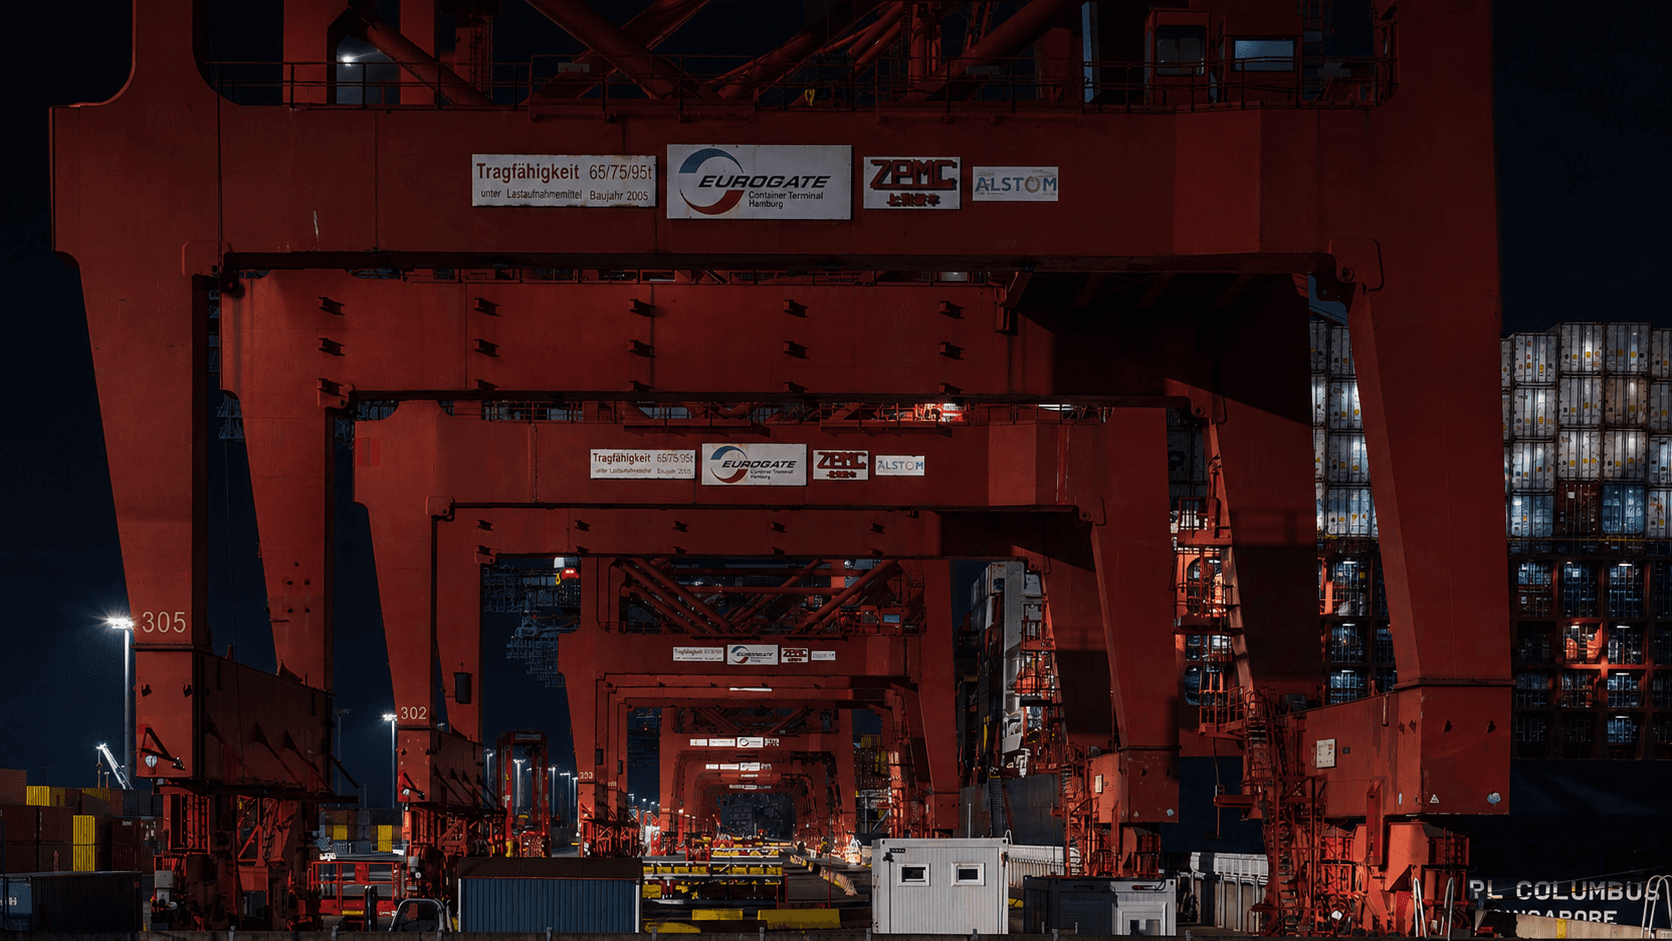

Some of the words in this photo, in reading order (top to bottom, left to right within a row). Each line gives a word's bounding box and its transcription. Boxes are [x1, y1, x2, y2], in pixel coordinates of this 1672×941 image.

[476, 163, 579, 184] Tragfähigkeit
[589, 164, 652, 180] 65/75/95t
[870, 159, 958, 190] ZPMC
[698, 175, 832, 188] EUROGATE
[974, 175, 1057, 194] ALSTOM
[480, 189, 501, 198] unter
[506, 188, 583, 199] Lastaufnahmemittel
[589, 190, 624, 202] Baujahr
[626, 190, 649, 201] 2005
[748, 190, 786, 199] Container
[788, 191, 824, 200] Terminal
[748, 200, 784, 209] Hamburg
[592, 452, 651, 465] Tragfähigkeit
[721, 460, 797, 469] EUROGATE
[877, 460, 924, 470] ALSTOM
[142, 611, 186, 633] 305
[400, 706, 427, 720] 302
[1516, 879, 1661, 901] COLUMBUS
[1493, 909, 1618, 925] APORE
